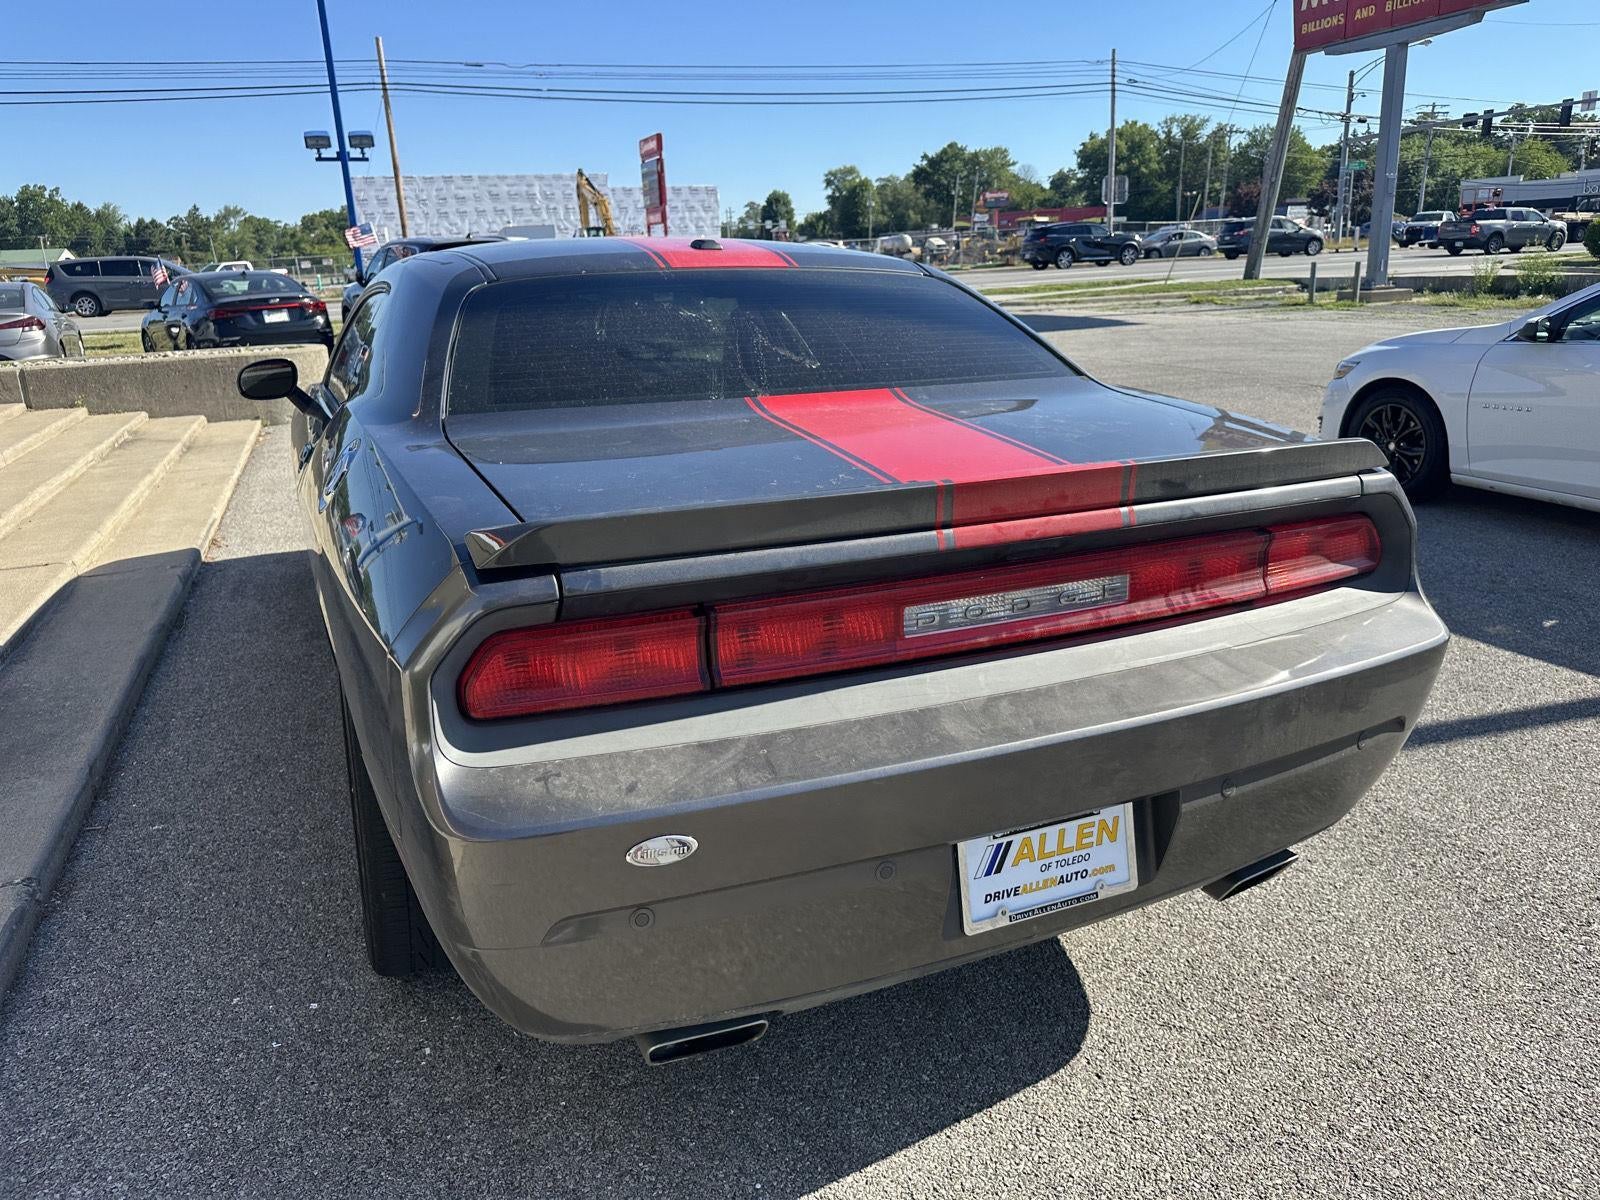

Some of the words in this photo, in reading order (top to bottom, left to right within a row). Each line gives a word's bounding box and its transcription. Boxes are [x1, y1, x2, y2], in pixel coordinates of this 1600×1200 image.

[1301, 13, 1345, 34] BILLIONS
[1354, 5, 1376, 21] AND
[915, 581, 1122, 628] DODGE
[1011, 815, 1120, 868] ALLEN
[1040, 862, 1053, 873] OF
[1055, 852, 1091, 869] TOLEDO
